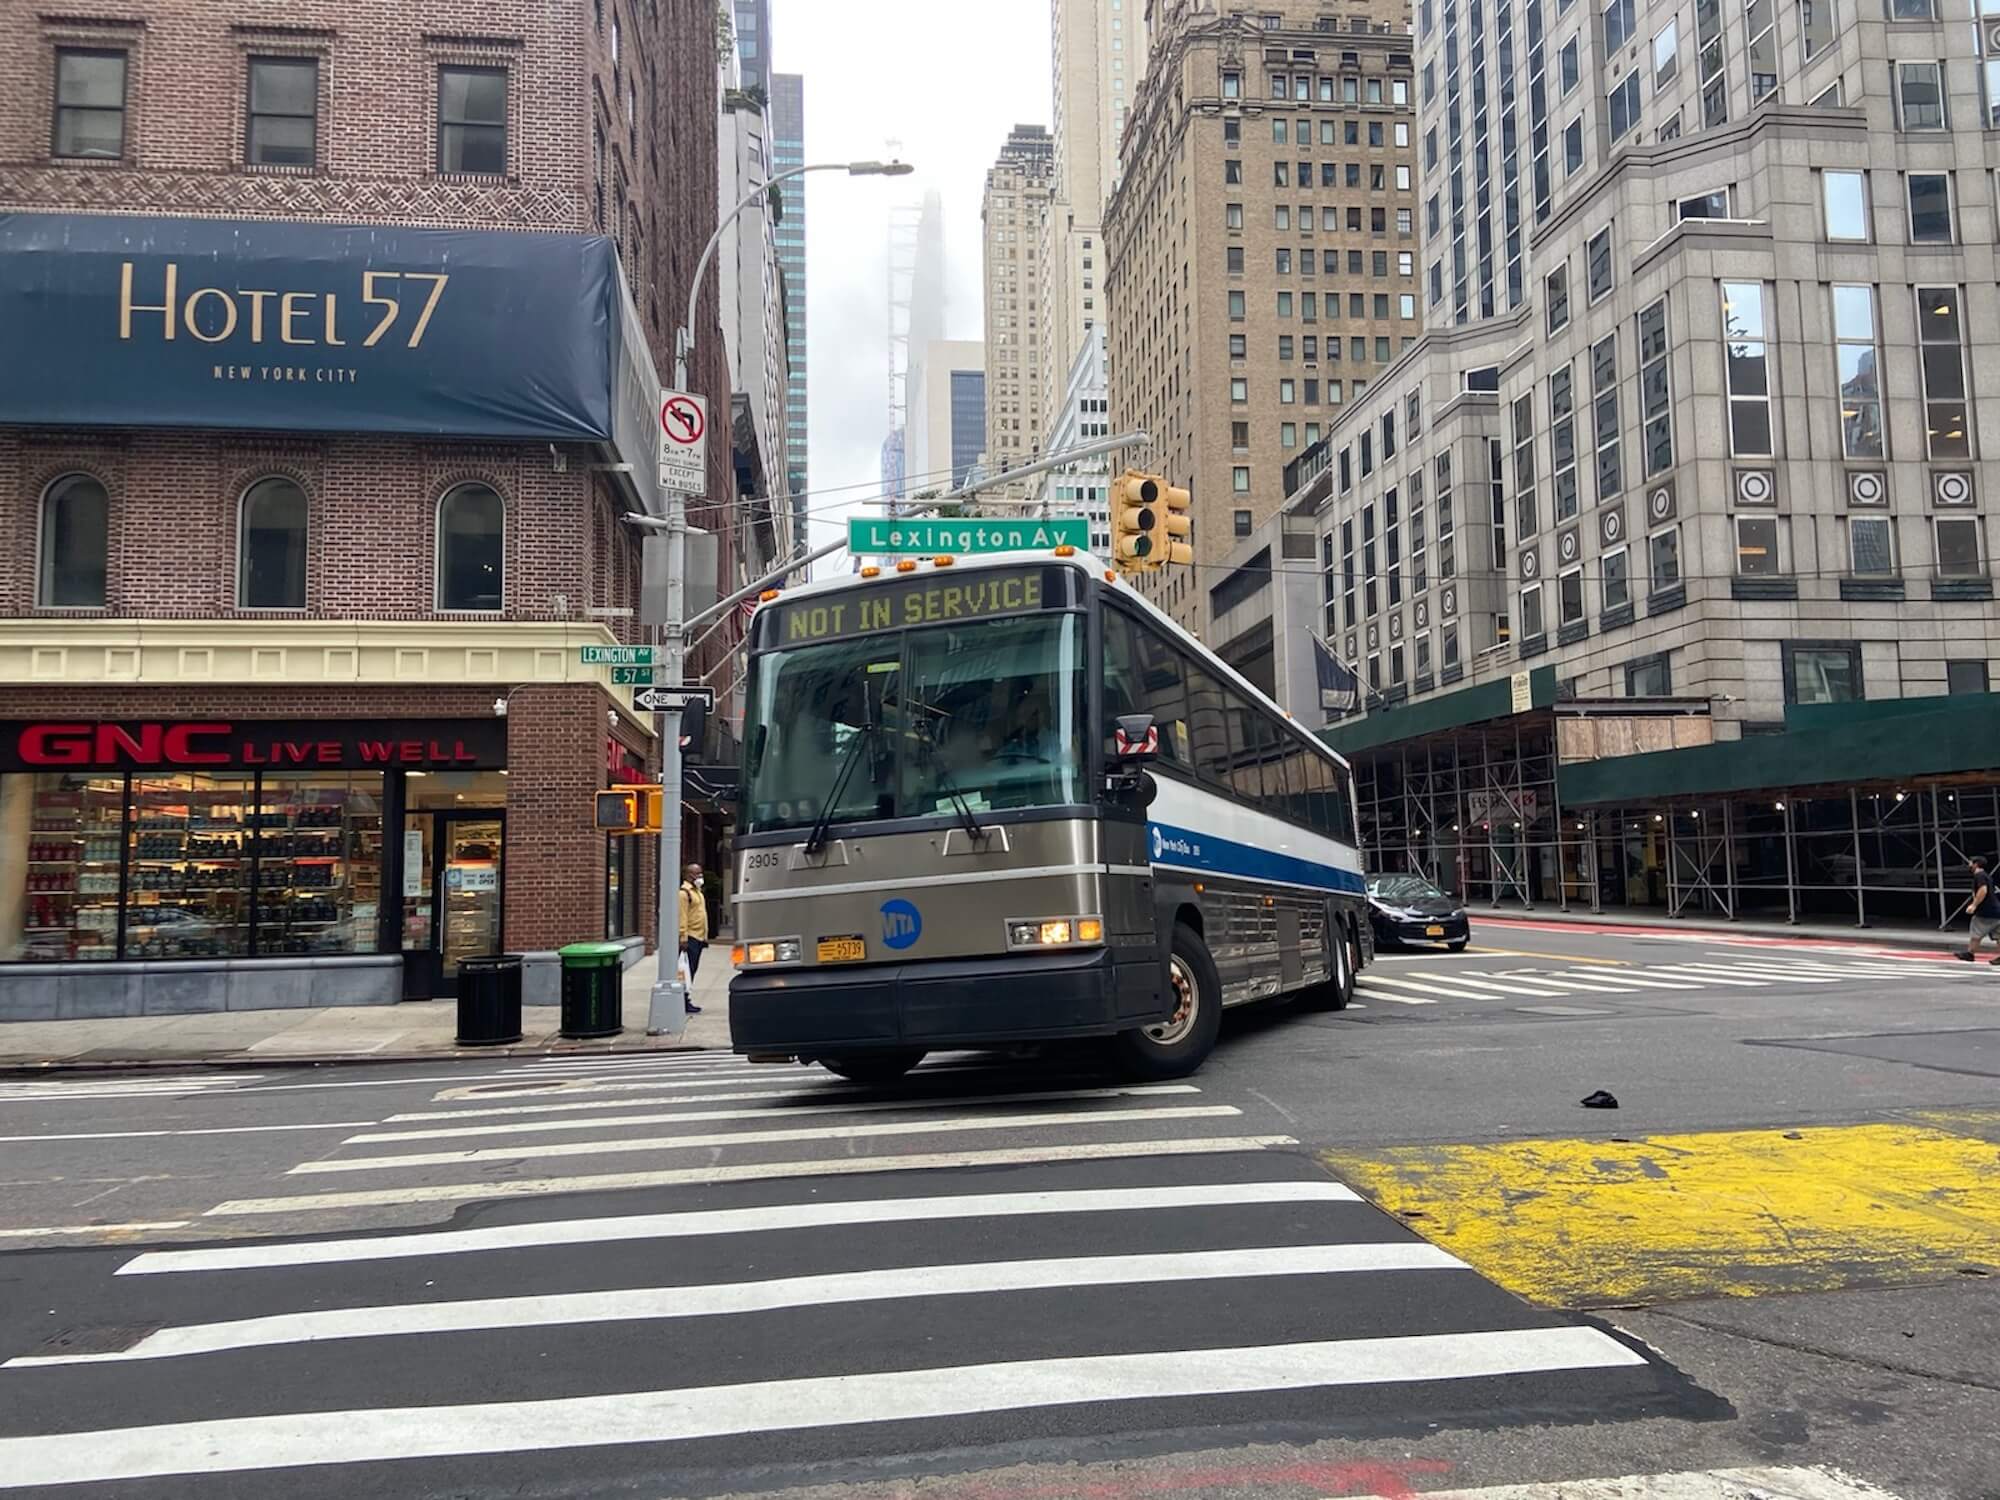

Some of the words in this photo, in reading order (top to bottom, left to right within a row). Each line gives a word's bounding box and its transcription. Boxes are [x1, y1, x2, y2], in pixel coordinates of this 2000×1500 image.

[119, 262, 346, 344] HOTEL
[362, 270, 449, 348] 57
[213, 365, 252, 380] NEW
[260, 367, 307, 382] YORK
[316, 368, 358, 383] CITY
[669, 467, 695, 479] EXCEPT
[662, 477, 677, 486] MTA
[678, 480, 702, 491] BUSES
[870, 527, 1023, 552] Lexington
[1032, 527, 1067, 547] Av
[789, 604, 846, 640] NOT
[859, 599, 891, 631] IN
[904, 575, 1042, 622] SERVICE
[582, 647, 636, 663] LEXINGTON
[637, 648, 650, 656] AV
[612, 669, 620, 683] E
[624, 668, 637, 683] 57
[643, 694, 668, 705] ONE
[18, 724, 232, 764] GNC
[243, 741, 345, 763] LIVE
[358, 741, 478, 762] WELL
[749, 853, 779, 868] 2905
[880, 911, 916, 939] MTA
